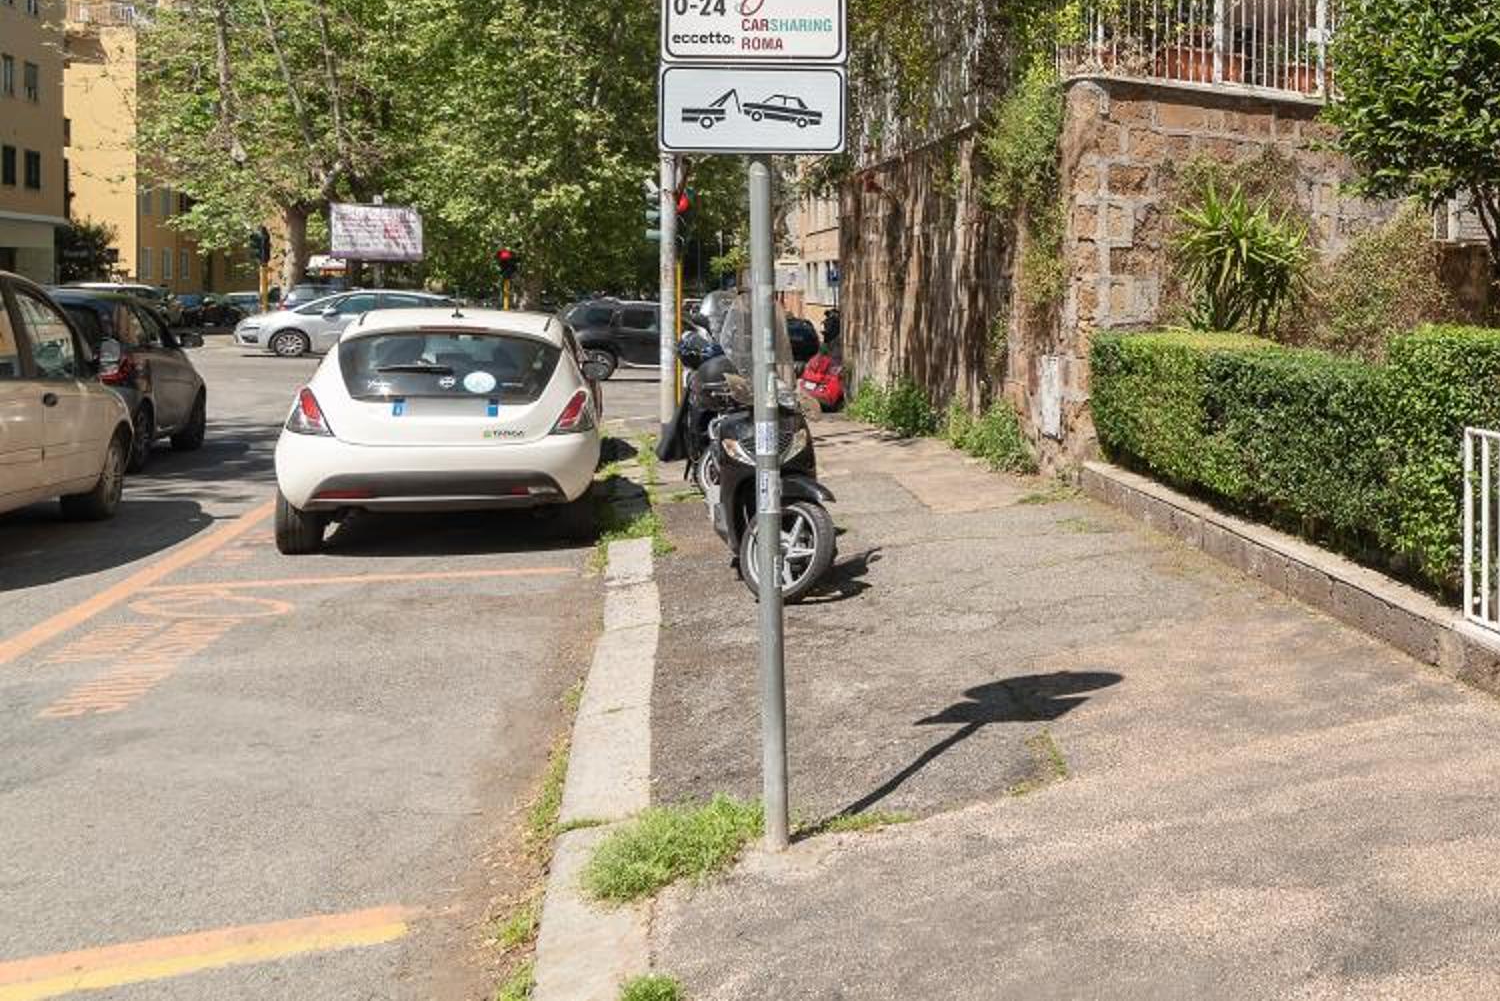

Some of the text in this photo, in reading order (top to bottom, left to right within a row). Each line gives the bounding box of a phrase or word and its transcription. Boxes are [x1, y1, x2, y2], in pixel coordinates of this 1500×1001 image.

[741, 18, 833, 32] CARSHARING
[672, 31, 735, 44] eccetto:
[741, 36, 784, 50] ROMA
